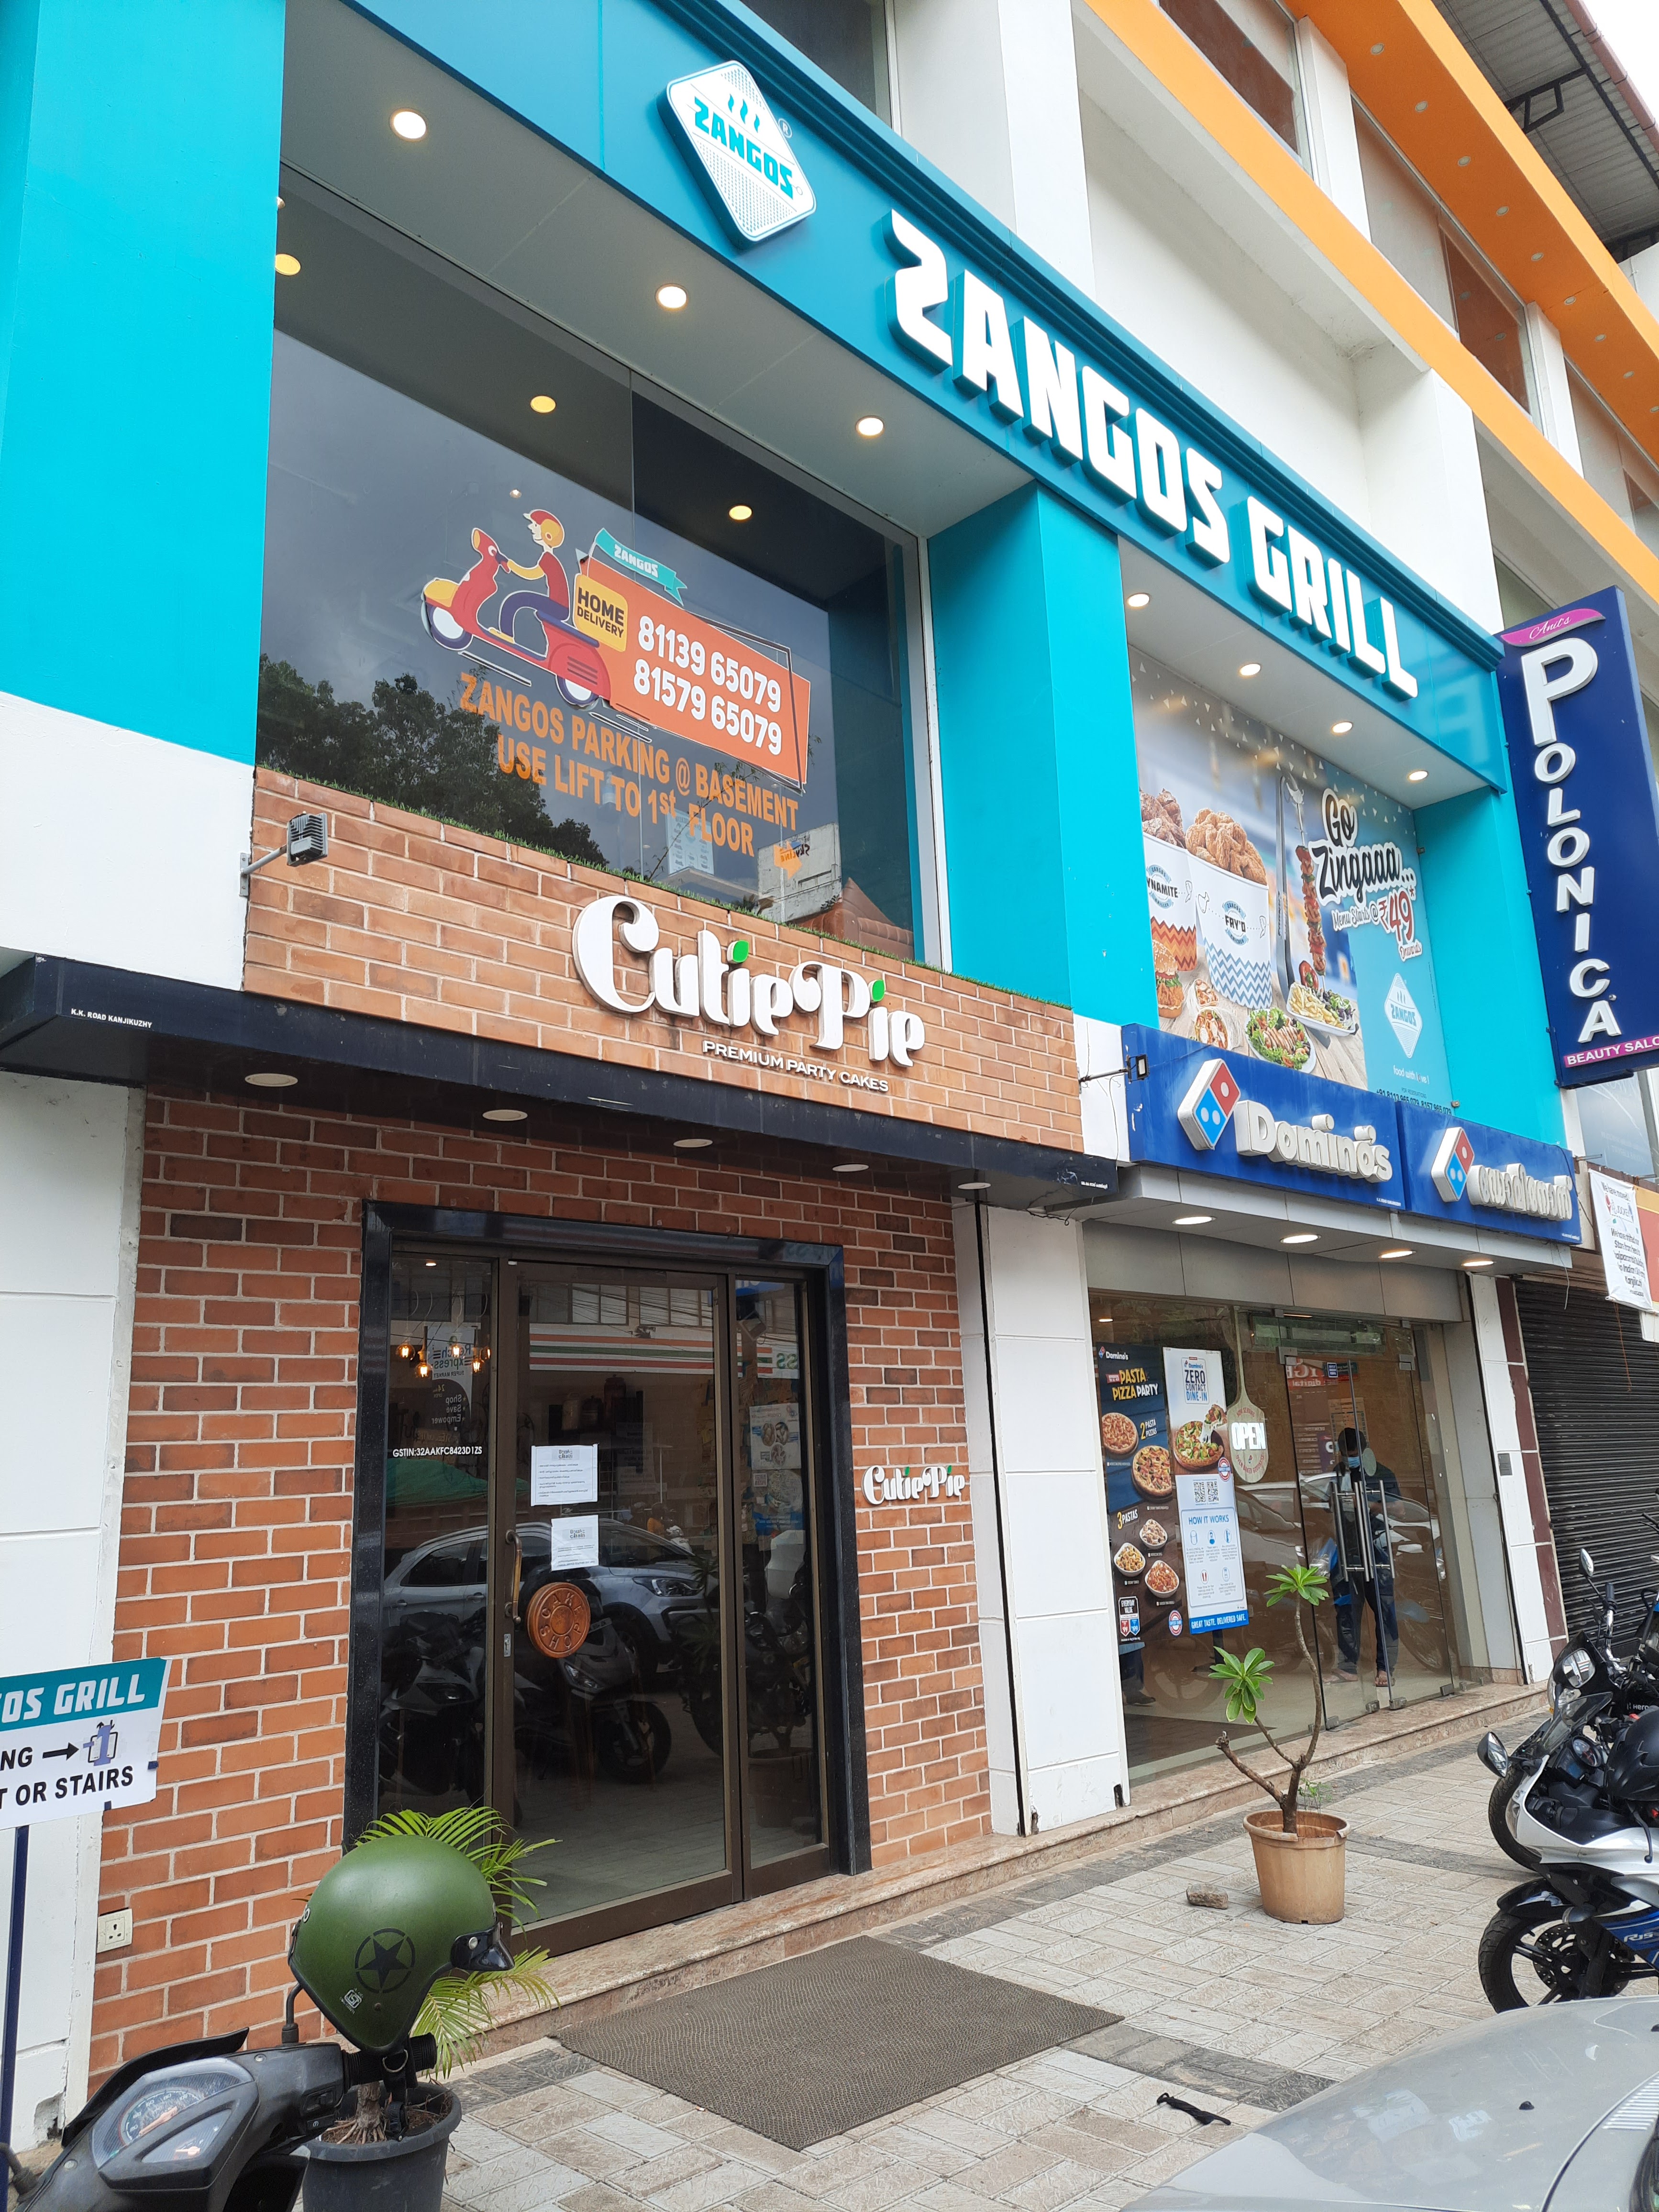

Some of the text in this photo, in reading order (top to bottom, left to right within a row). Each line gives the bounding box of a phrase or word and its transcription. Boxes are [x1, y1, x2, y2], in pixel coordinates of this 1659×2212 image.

[694, 96, 794, 200] ZANGOS
[883, 209, 1417, 698] ZANGOS GRILL
[614, 543, 659, 578] ZANGOS
[577, 587, 625, 626] HOME
[576, 607, 624, 639] DELIVERY
[638, 616, 782, 713] 81139 65079
[634, 659, 782, 755] 81579 65079
[460, 673, 564, 745] ZANGOS
[572, 714, 670, 785] PARKING
[696, 763, 798, 830] BASEMENT
[498, 734, 547, 784] USE
[554, 757, 604, 804] LIFT
[611, 776, 641, 817] TO
[648, 789, 676, 824] 1st
[689, 804, 754, 857] FLOOR
[1521, 638, 1621, 1042] POLONICA
[1333, 910, 1350, 927] Menu
[1350, 907, 1370, 925] Starts
[88, 1011, 106, 1020] ROAD
[108, 1015, 153, 1029] KANJIKUZHY
[1390, 1004, 1417, 1027] ZANGOS
[703, 1040, 889, 1093] PREMIUM PARTY CAKES
[1567, 1043, 1621, 1066] BEAUTY
[1393, 1064, 1405, 1077] food
[1234, 1100, 1393, 1183] Domino's
[1106, 1351, 1129, 1360] Domino's
[1119, 1368, 1147, 1385] PASTA
[1184, 1370, 1206, 1384] ZERO
[1185, 1383, 1206, 1392] CONTACT
[1112, 1383, 1158, 1401] PIZZA PARTY
[1140, 1419, 1156, 1440] 2 PASTA
[1231, 1422, 1266, 1450] OPEN
[1117, 1509, 1139, 1530] 3 PASTAS
[1188, 1515, 1229, 1525] HOW IT WORKS
[542, 1592, 584, 1619] CAKE
[1191, 1620, 1203, 1629] GREAT
[1217, 1615, 1236, 1625] DELIVERED
[540, 1623, 582, 1650] SHOP
[0, 1674, 145, 1723] OS GRILL
[0, 1747, 33, 1770] NG
[15, 1781, 46, 1806] OR
[55, 1766, 133, 1799] STAIRS
